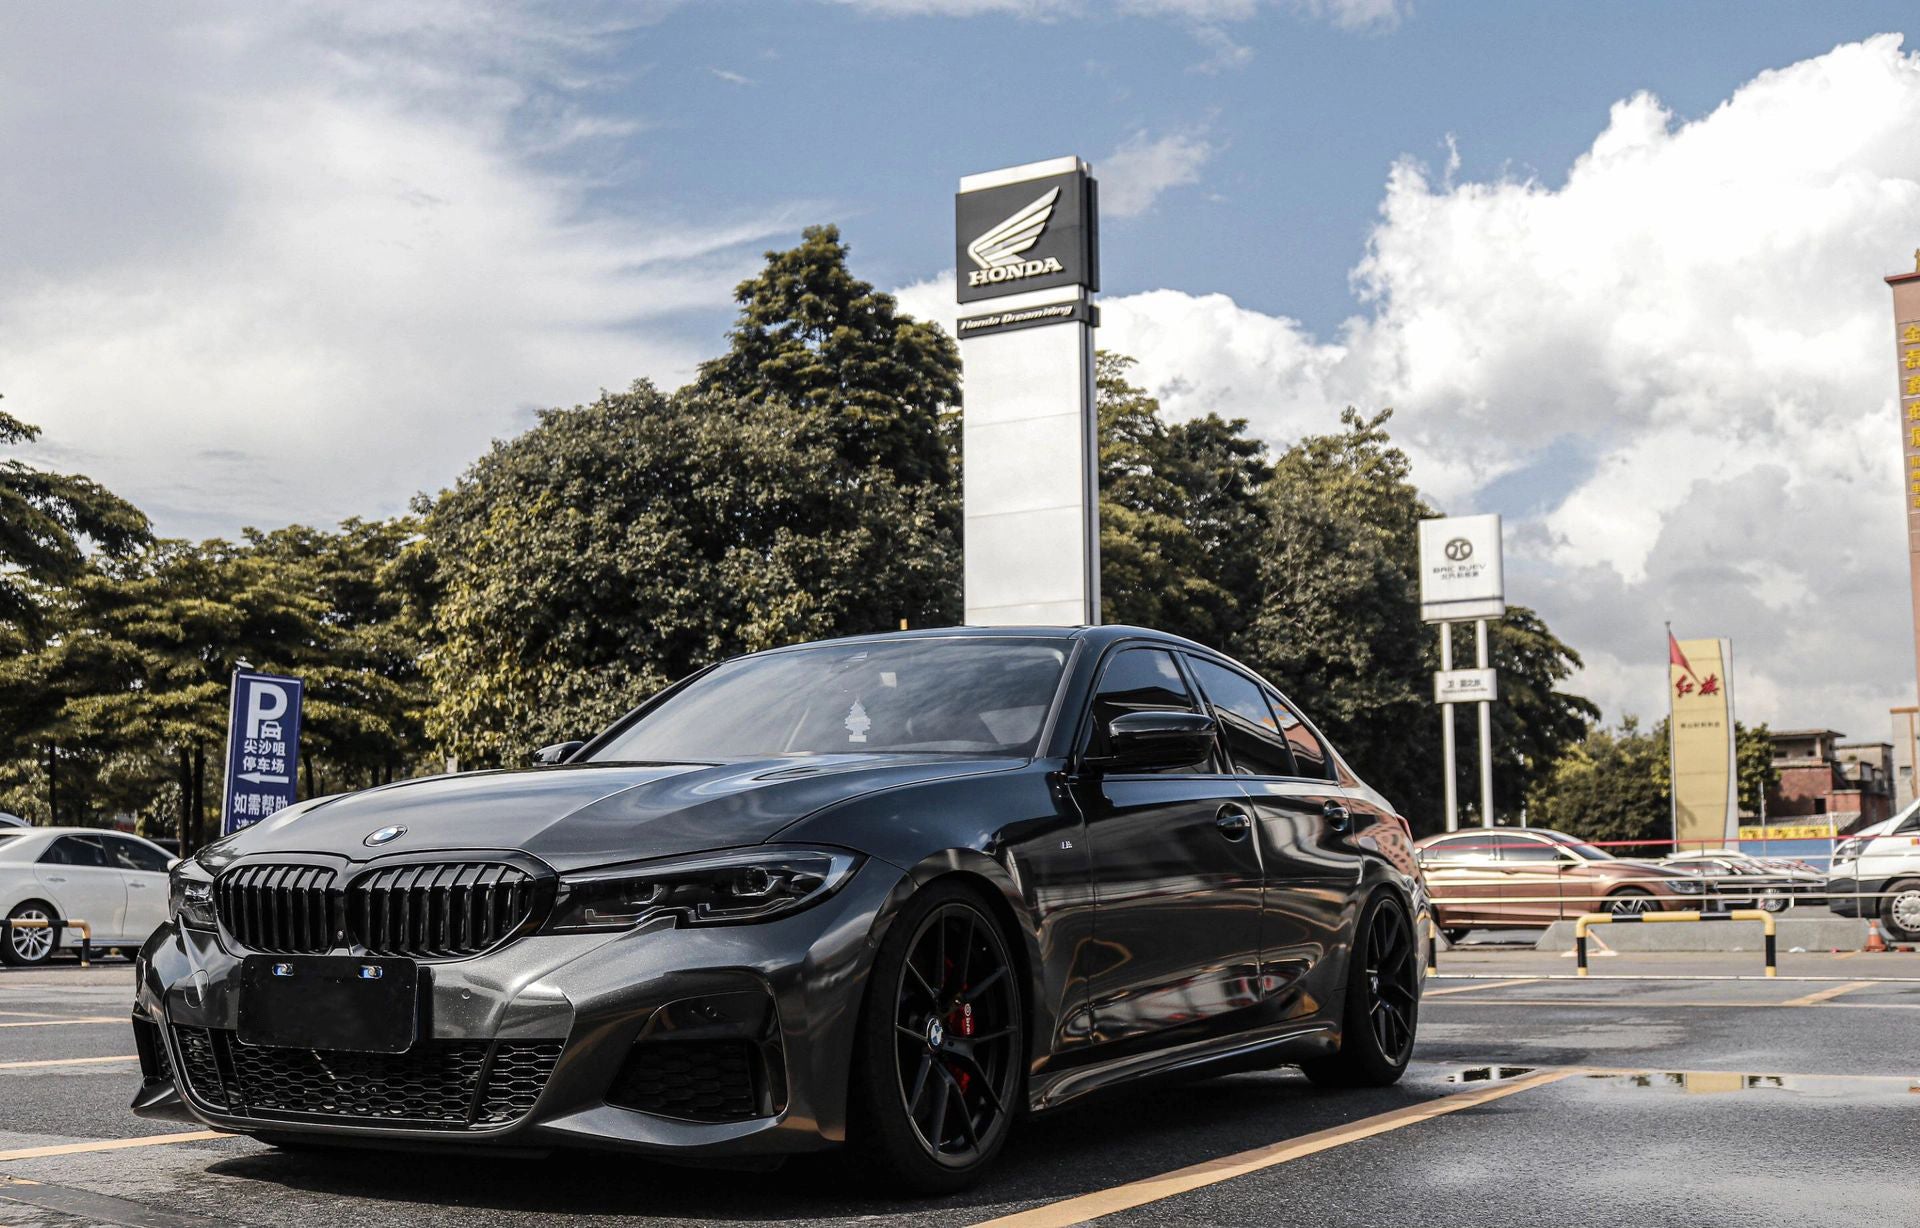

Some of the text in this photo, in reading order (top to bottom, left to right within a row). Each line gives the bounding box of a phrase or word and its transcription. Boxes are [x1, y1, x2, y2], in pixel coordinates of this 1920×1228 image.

[968, 257, 1064, 287] HONDA
[960, 315, 1000, 331] Honda
[1675, 673, 1721, 699] 红旗
[246, 681, 288, 739] P
[244, 739, 286, 757] 尖沙咀
[242, 755, 285, 774] 停车场
[233, 791, 289, 816] 如需帮助
